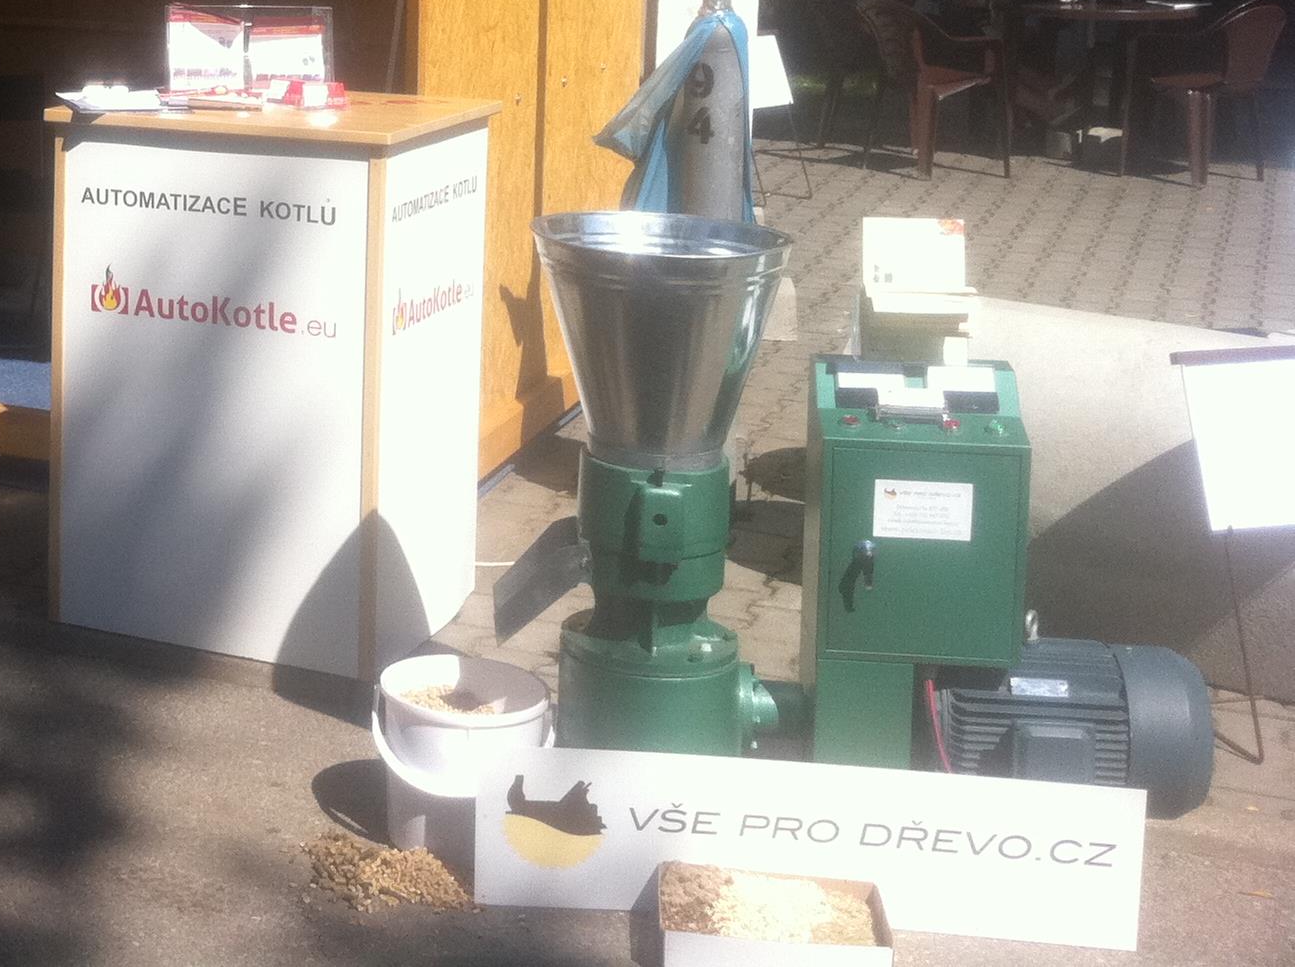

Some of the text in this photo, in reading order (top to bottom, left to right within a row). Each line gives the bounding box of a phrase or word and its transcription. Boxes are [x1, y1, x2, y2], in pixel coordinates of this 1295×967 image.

[81, 186, 337, 226] AUTOMATIZACE KOTLŮ
[391, 184, 450, 223] AUTOMATIZACE
[628, 803, 1118, 868] VŠE PRO DŘEVO.CZ
